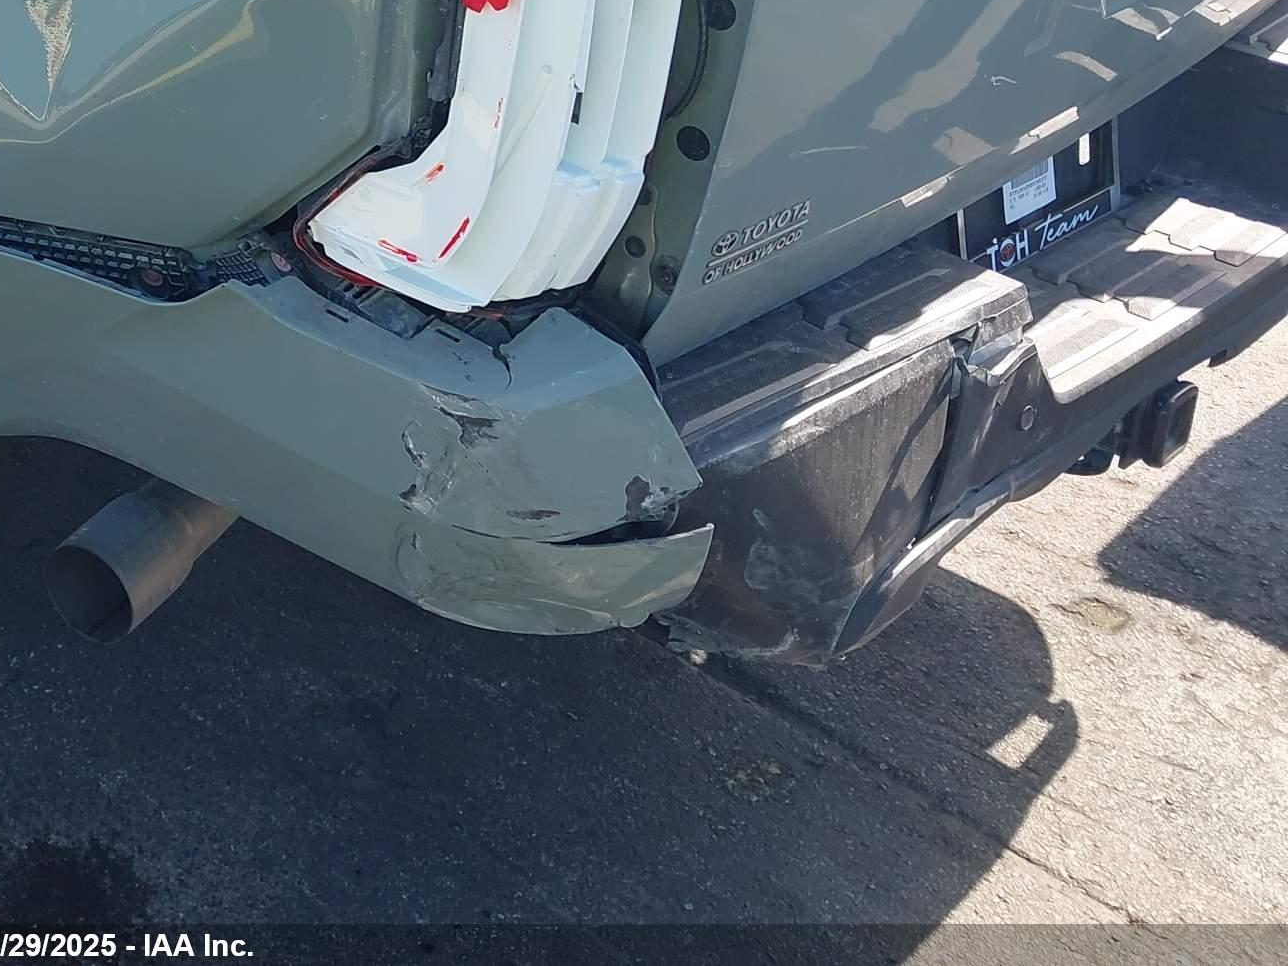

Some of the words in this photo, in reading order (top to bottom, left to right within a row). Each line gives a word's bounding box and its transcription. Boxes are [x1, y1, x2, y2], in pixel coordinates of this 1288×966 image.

[741, 199, 811, 244] TOYOTA
[1034, 204, 1099, 250] Team
[703, 268, 722, 284] OF
[723, 228, 803, 275] HOLLYWOOD
